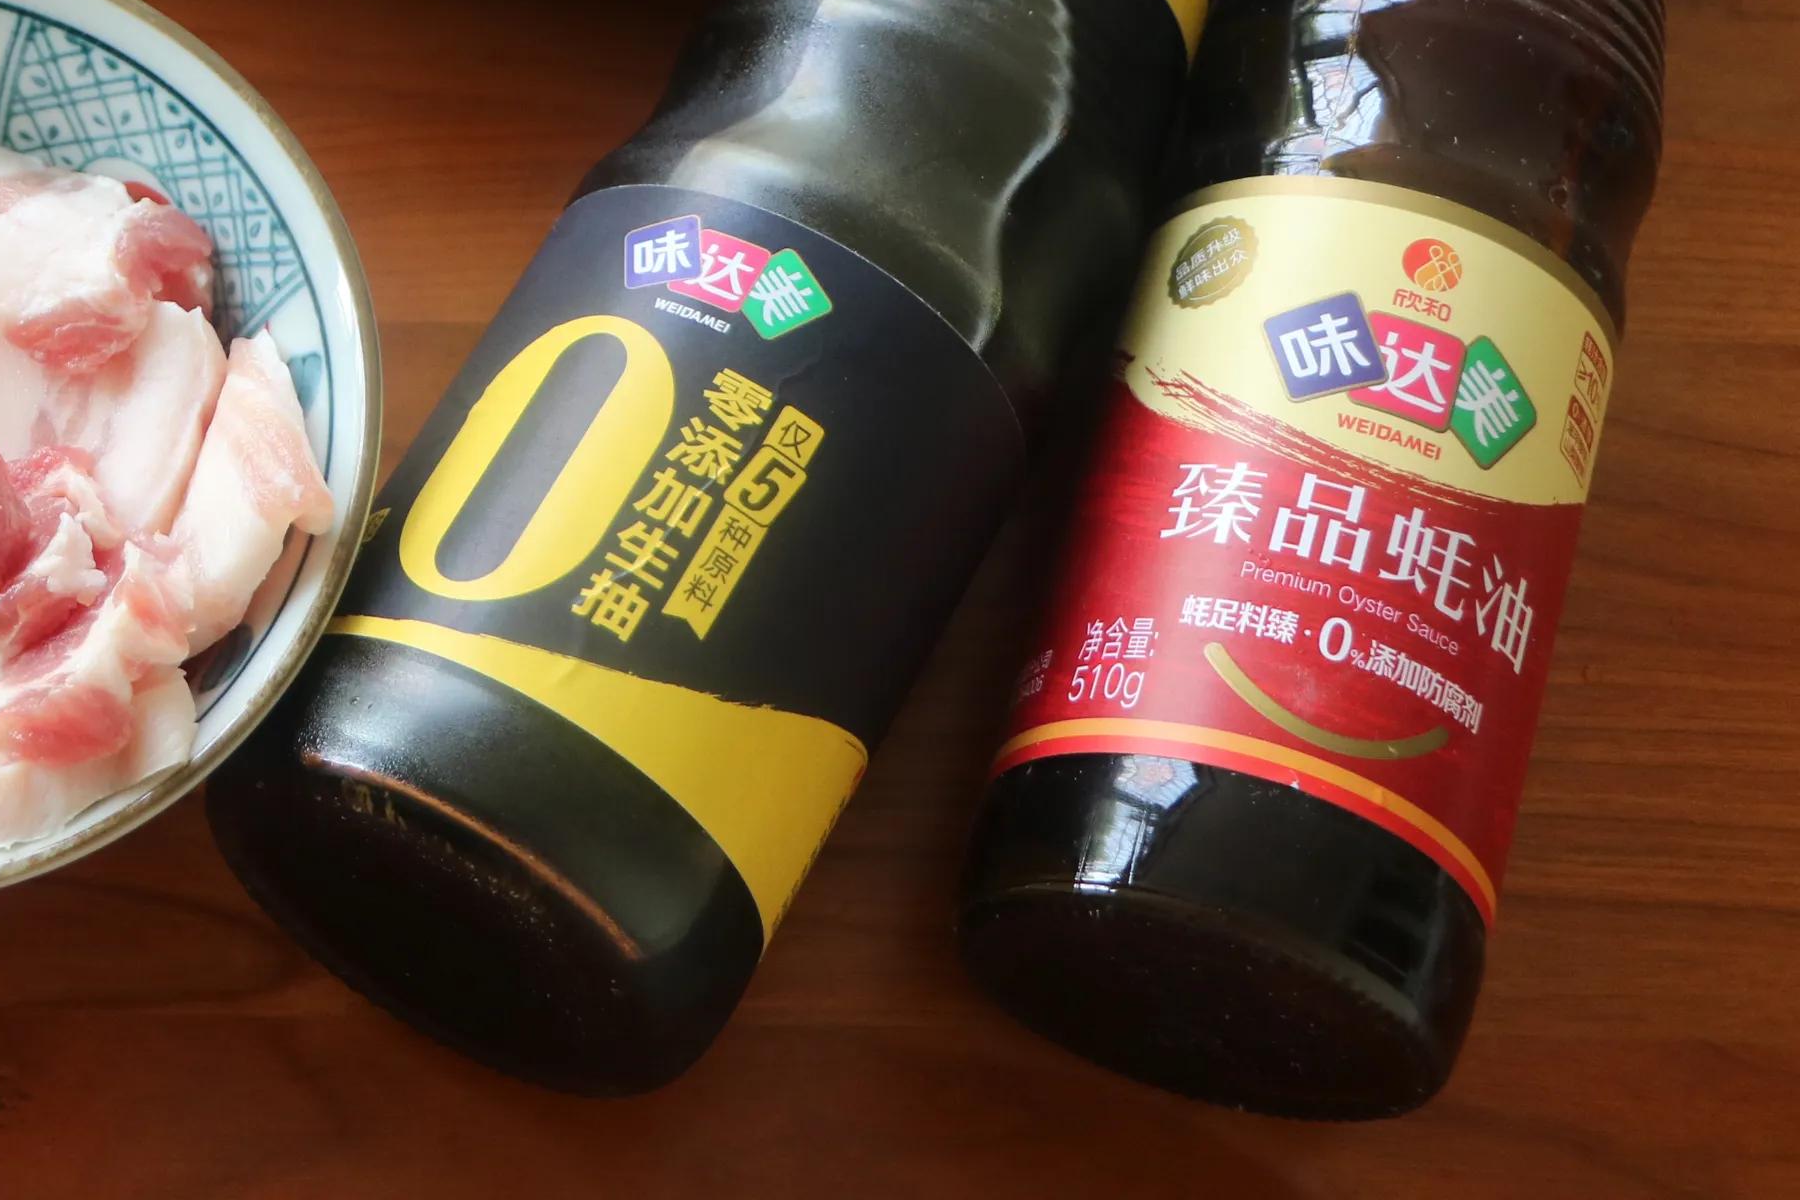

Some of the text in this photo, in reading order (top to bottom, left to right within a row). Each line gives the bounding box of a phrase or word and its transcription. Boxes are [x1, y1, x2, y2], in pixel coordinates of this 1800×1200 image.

[633, 229, 814, 327] 味达美
[654, 297, 732, 334] WEIDAMEI
[1392, 288, 1452, 322] 欣和
[1279, 312, 1521, 448] 味达美
[399, 314, 675, 601] 0
[1337, 412, 1443, 461] WEIDAMEI
[571, 367, 773, 643] 零添加生抽
[683, 420, 811, 613] 仅5种原料
[1159, 461, 1535, 674] 臻品蚝油
[1240, 560, 1460, 656] Premium Oyster Sauce
[1067, 662, 1146, 708] 510g
